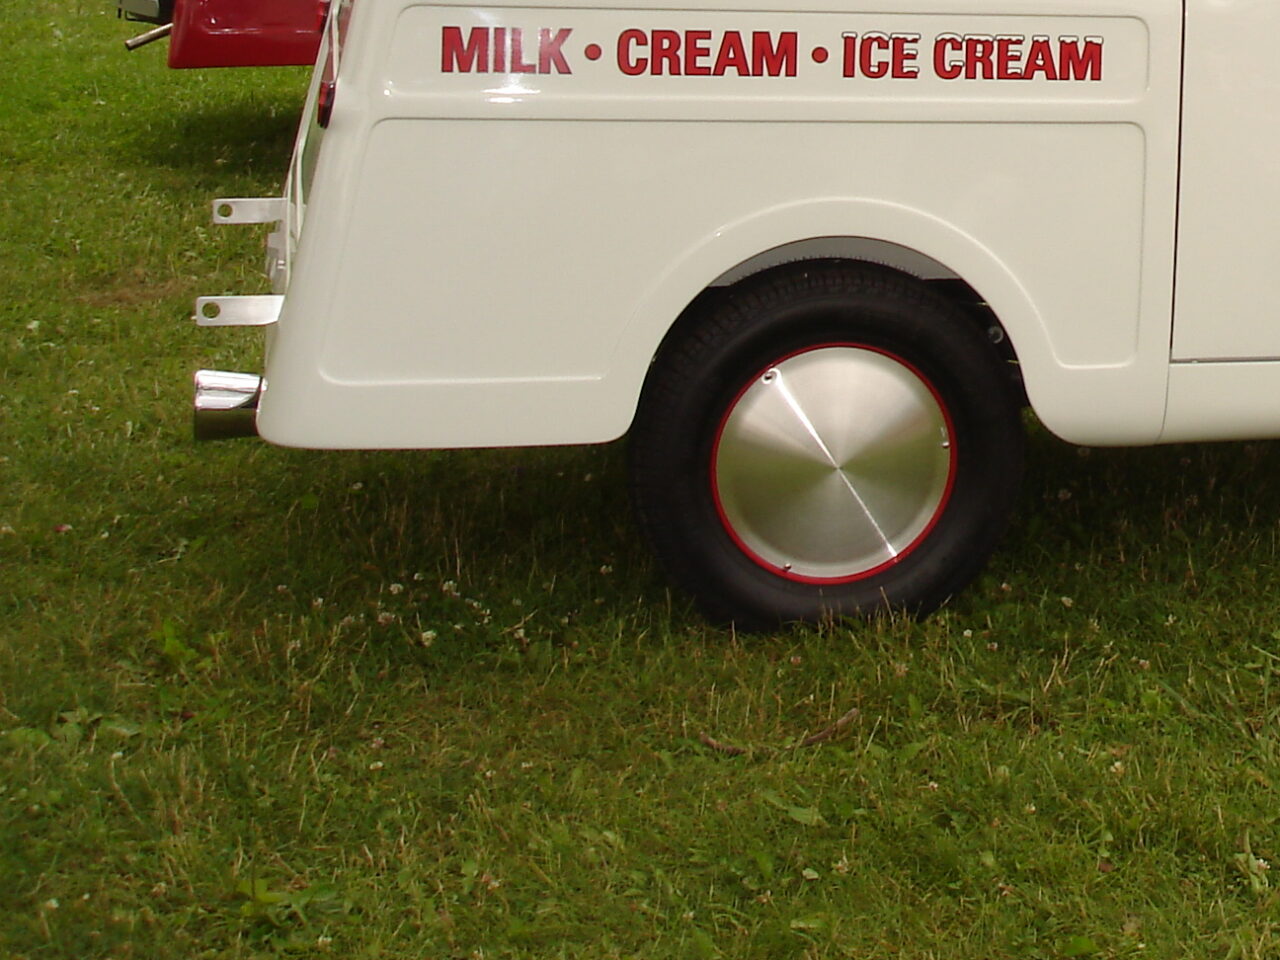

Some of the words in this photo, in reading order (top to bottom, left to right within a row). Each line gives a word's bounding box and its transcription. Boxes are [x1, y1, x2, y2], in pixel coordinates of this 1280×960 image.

[441, 26, 573, 74] MILK
[616, 28, 797, 77] CREAM
[842, 31, 920, 79] ICE
[932, 32, 1103, 81] CREAM
